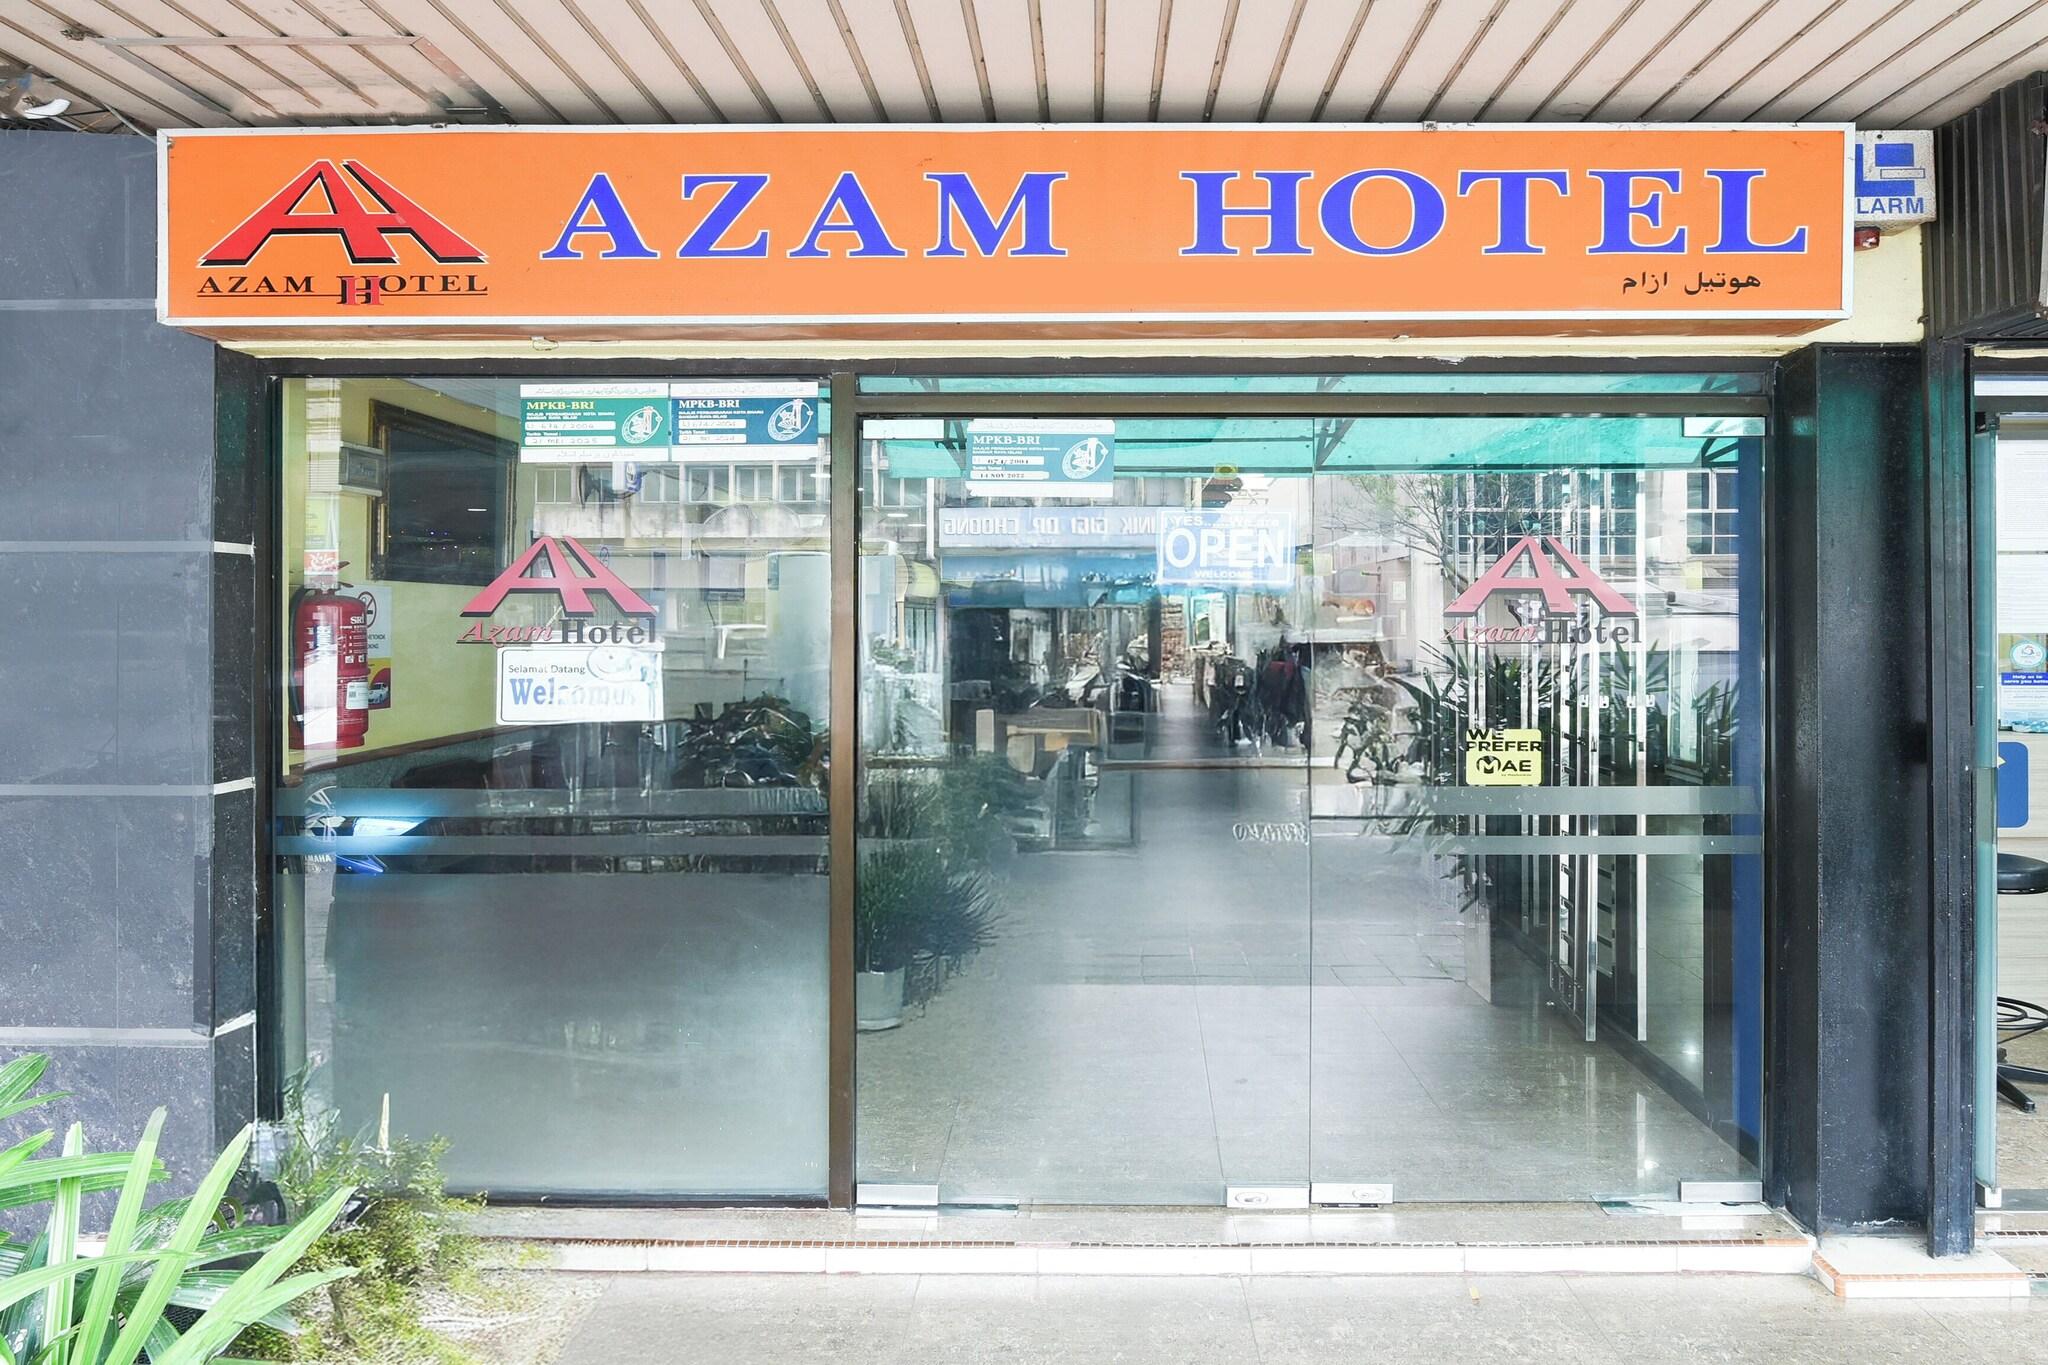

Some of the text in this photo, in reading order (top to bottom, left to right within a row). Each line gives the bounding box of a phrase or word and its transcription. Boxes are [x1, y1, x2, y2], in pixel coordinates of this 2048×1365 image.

[539, 168, 1809, 260] AZAM HOTEL
[198, 274, 488, 306] AZAM HOTEL
[1684, 271, 1762, 296] هوتيل
[526, 401, 595, 411] MPKB-BRI
[678, 398, 741, 410] MPKB-BRI
[972, 435, 1041, 446] MPKB-BRI
[1165, 528, 1285, 568] OPEN
[456, 618, 657, 647] Azam Hotel
[1441, 618, 1643, 647] Azam Hotel
[551, 664, 586, 676] Datang
[1468, 728, 1505, 740] WE
[1466, 740, 1543, 751] PREFER
[1476, 755, 1532, 774] MAE
